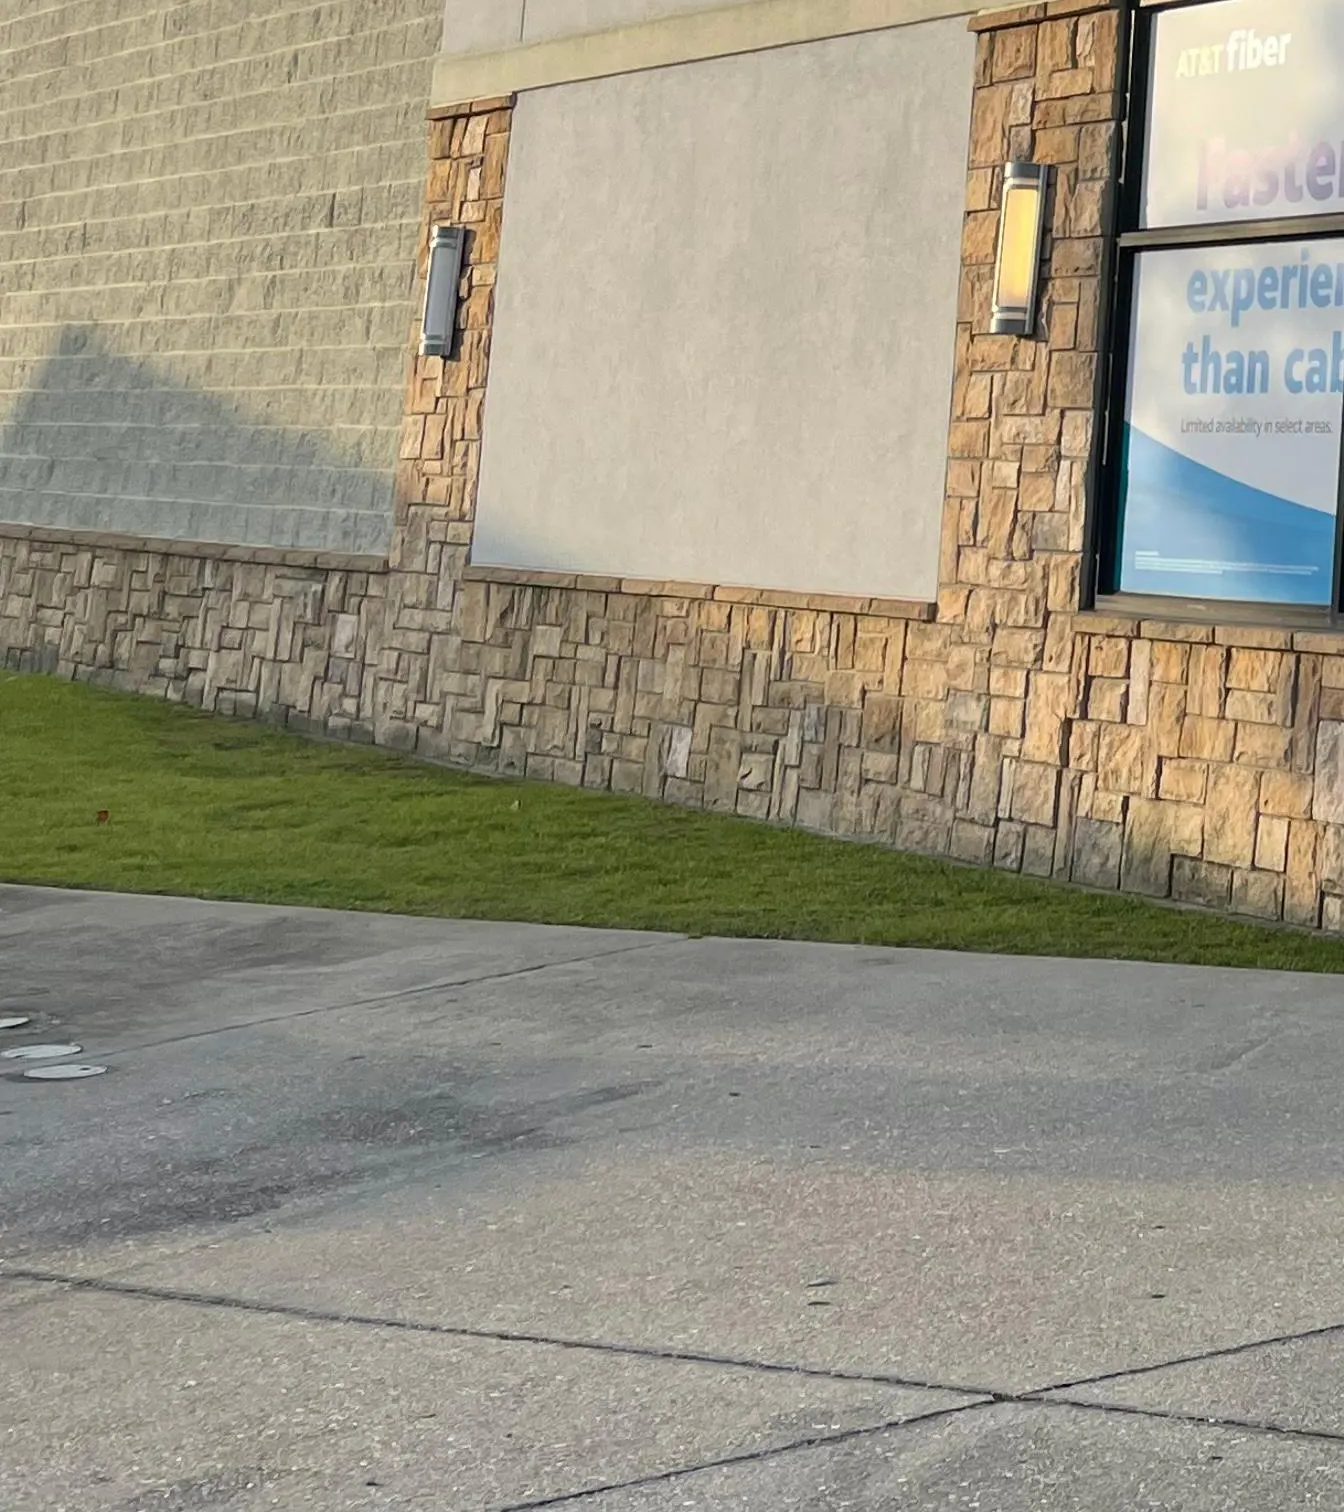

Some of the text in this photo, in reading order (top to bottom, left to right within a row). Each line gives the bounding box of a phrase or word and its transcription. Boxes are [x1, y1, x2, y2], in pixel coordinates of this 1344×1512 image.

[1176, 28, 1291, 78] AT&T fiber
[1181, 334, 1269, 394] than
[1181, 417, 1214, 434] Limited
[1215, 417, 1261, 437] availability
[1264, 417, 1273, 434] in
[1275, 417, 1303, 434] select
